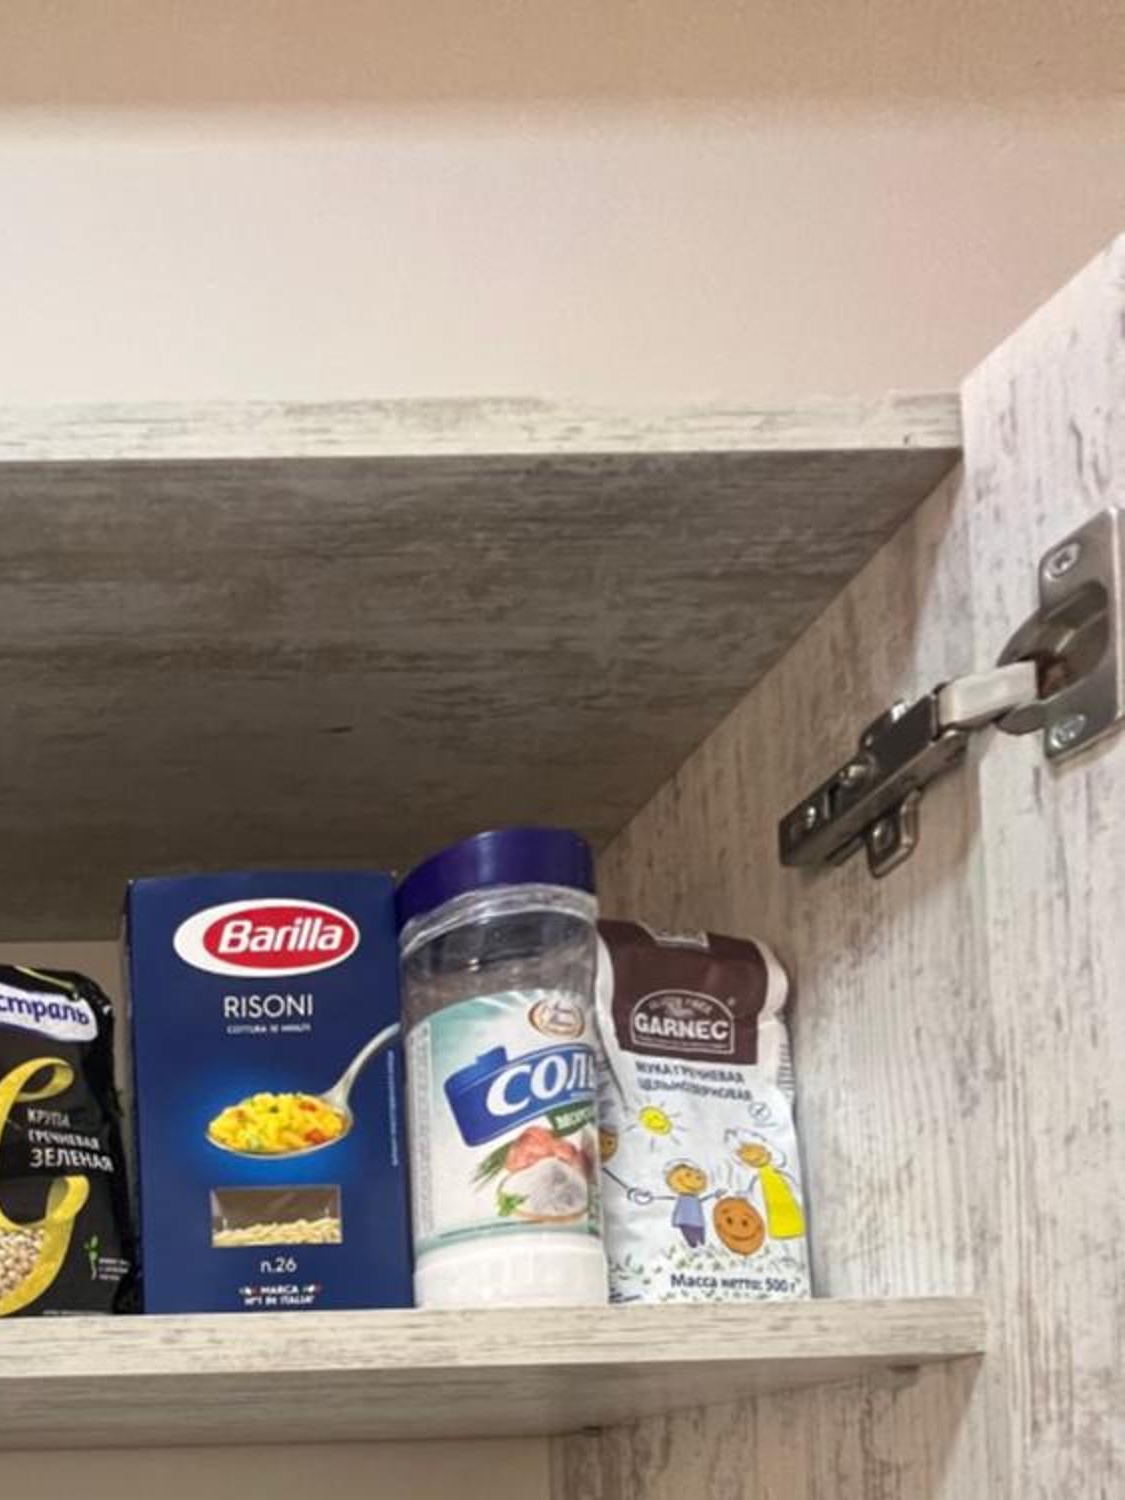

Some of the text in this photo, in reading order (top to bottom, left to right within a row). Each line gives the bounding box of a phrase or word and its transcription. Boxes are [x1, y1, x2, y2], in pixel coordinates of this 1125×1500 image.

[218, 917, 343, 954] Barilla
[224, 994, 313, 1018] RISONI
[634, 1012, 729, 1040] GARNEC
[27, 1108, 71, 1128] КРУПА
[28, 1128, 100, 1150] ГРЕЧНЕВАЯ
[29, 1148, 114, 1171] ЗЕЛЕНАЯ
[260, 1257, 297, 1273] n.26
[670, 1273, 717, 1288] Масса
